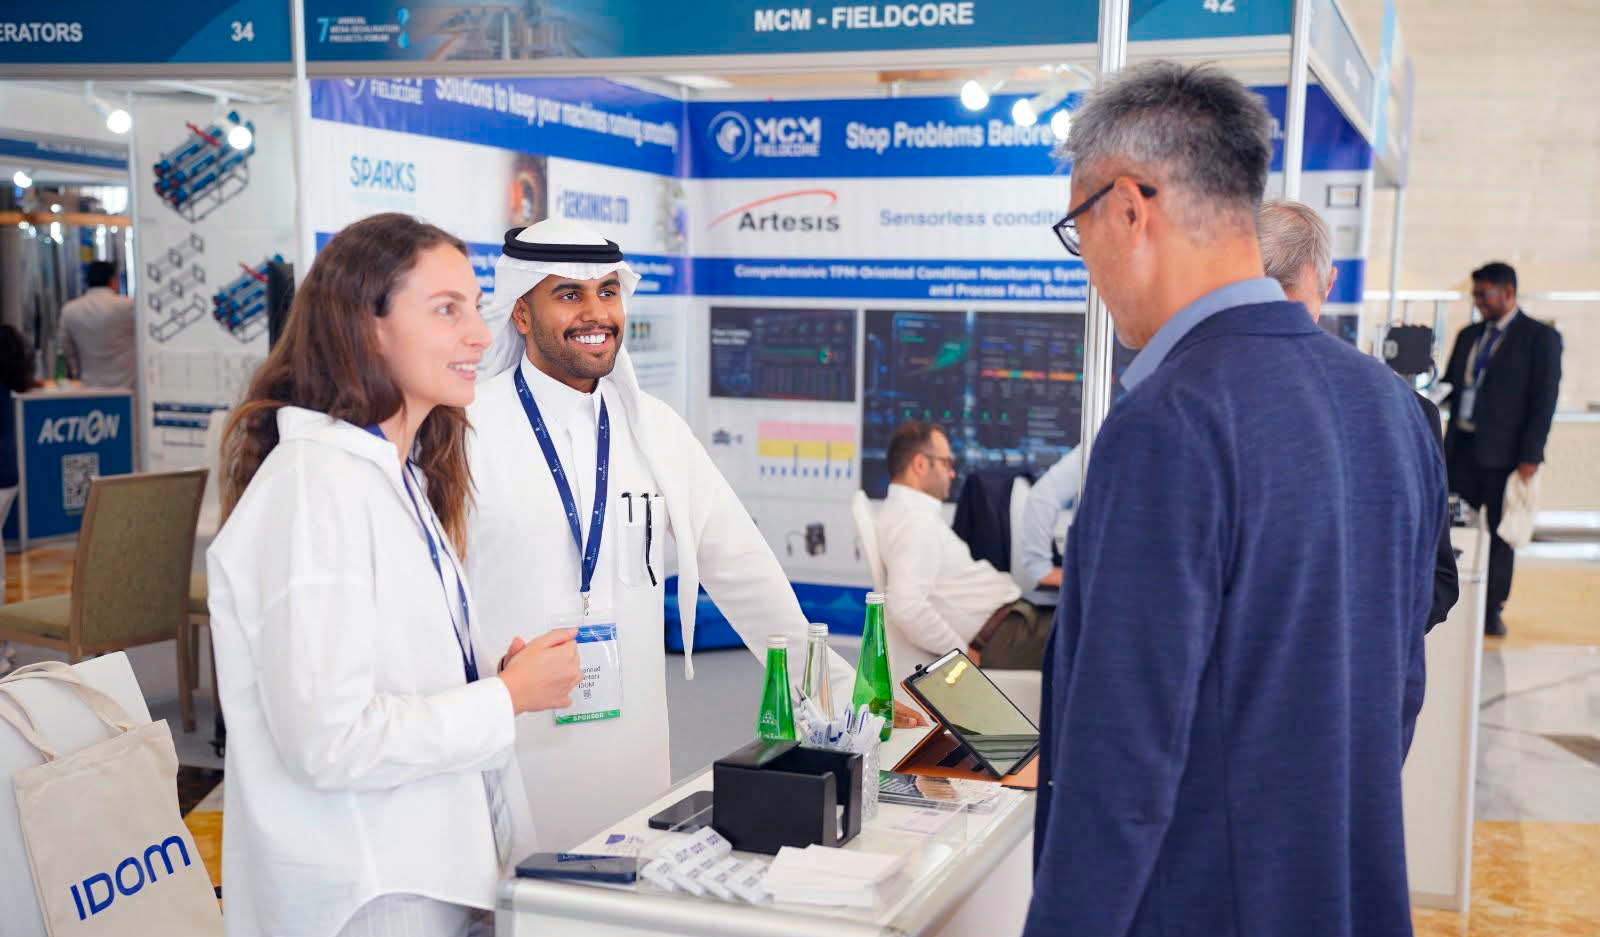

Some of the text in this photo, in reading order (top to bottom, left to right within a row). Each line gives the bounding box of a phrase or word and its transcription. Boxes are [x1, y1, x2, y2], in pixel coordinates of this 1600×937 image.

[754, 8, 812, 32] MCM
[832, 2, 975, 29] FIELDCORE
[1203, 0, 1235, 13] 42
[230, 21, 255, 42] 34
[436, 79, 679, 153] Solutions to keep your machines running smoothly
[754, 117, 822, 143] MCM
[845, 119, 1052, 155] Stop Problems Before
[350, 155, 417, 193] SPARKS
[738, 212, 840, 232] Artesis
[879, 209, 986, 227] Sensorless
[733, 264, 828, 281] Comprehensive
[916, 265, 979, 281] Condition
[979, 266, 1051, 284] Monitoring
[928, 283, 954, 297] and
[956, 284, 1006, 298] Process
[1008, 284, 1042, 298] Fault
[37, 410, 120, 445] ACTION
